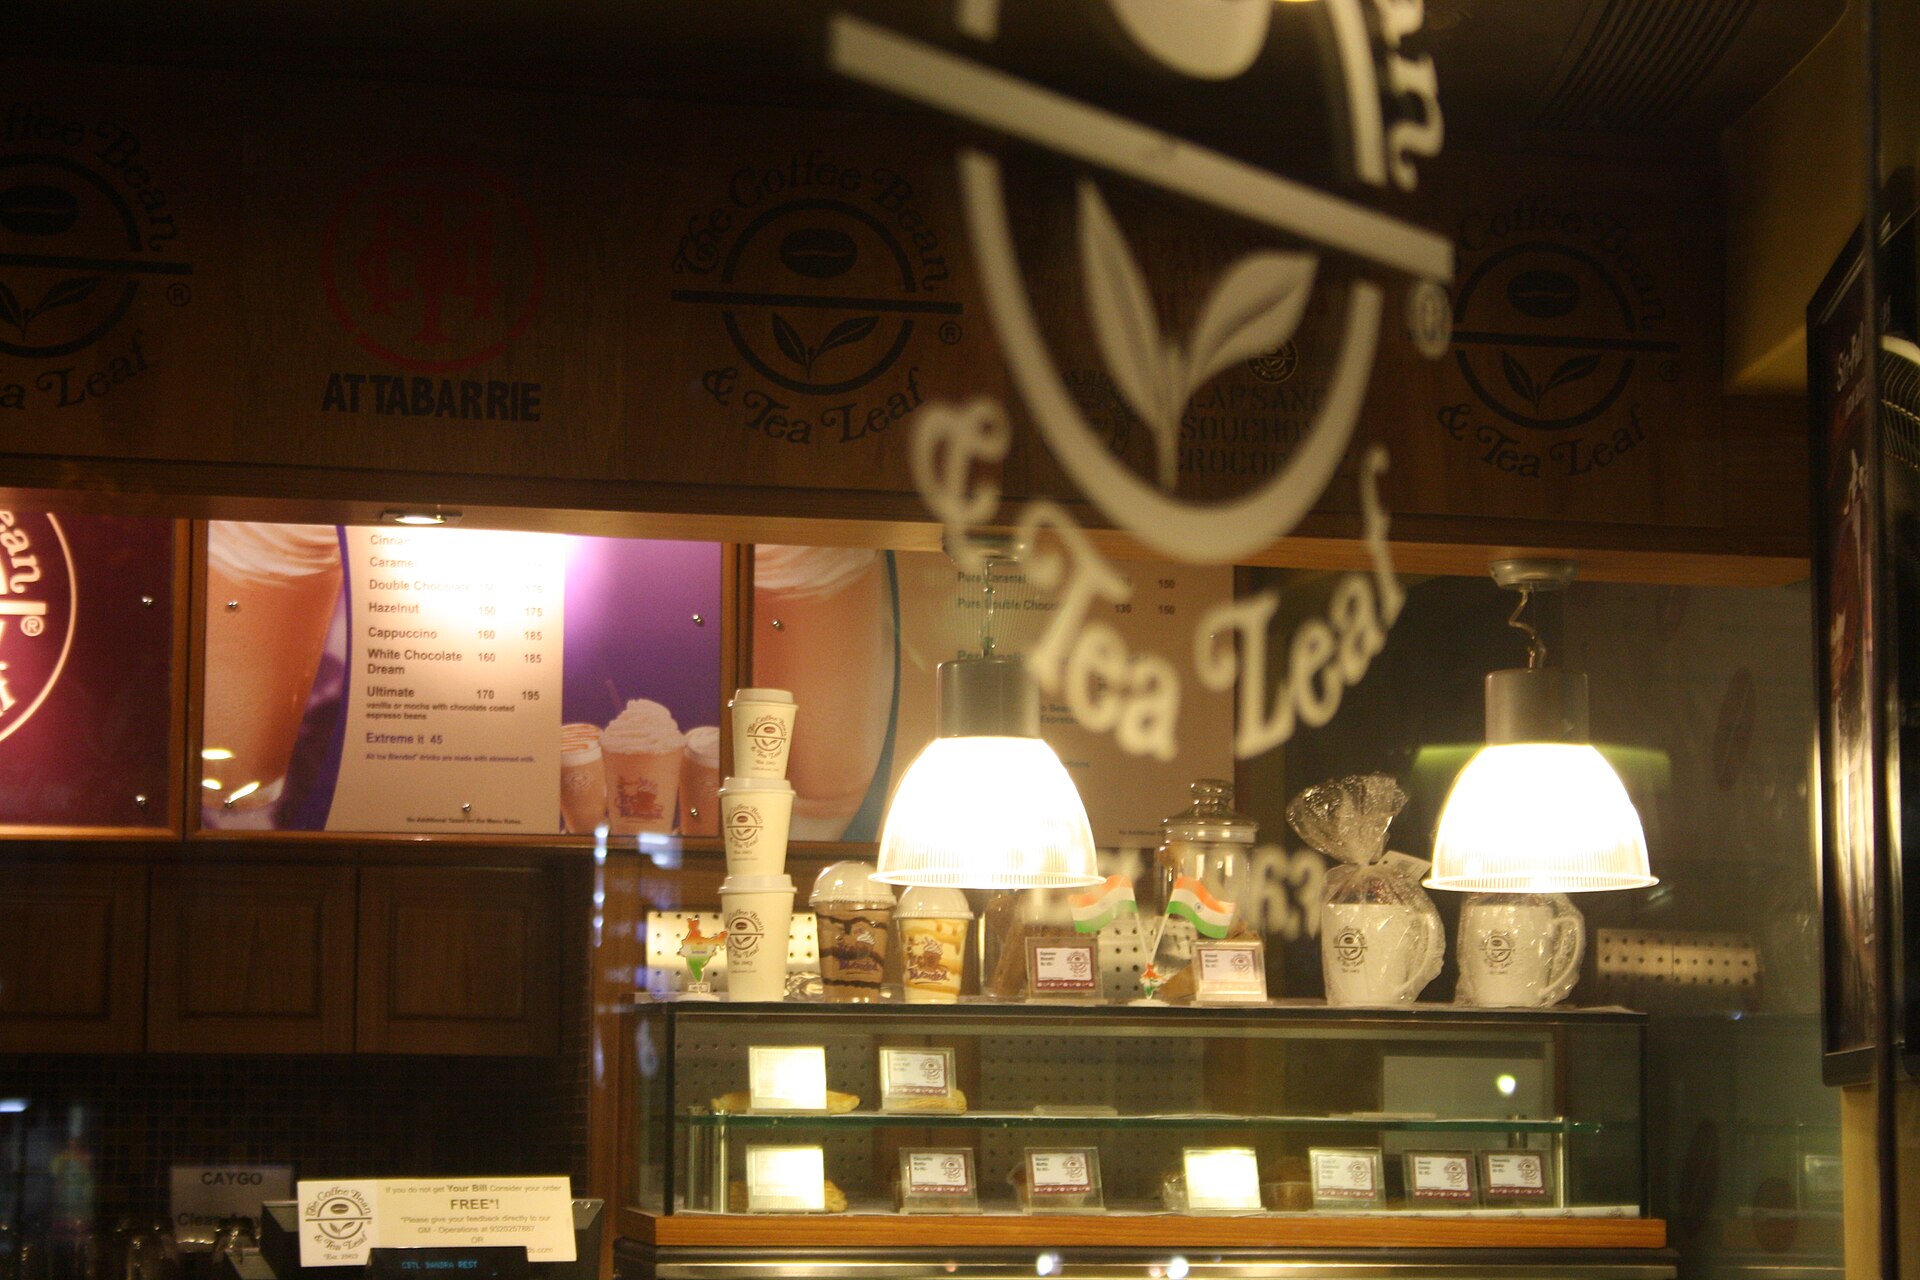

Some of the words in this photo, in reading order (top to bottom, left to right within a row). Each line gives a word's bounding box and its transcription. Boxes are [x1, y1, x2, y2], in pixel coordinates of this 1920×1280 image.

[33, 327, 149, 409] Leaf
[742, 389, 812, 444] Tea
[820, 365, 924, 444] Leaf
[1476, 424, 1541, 479] Tea
[1551, 402, 1646, 477] Leaf
[369, 579, 410, 591] Double
[368, 602, 420, 614] Hazelnut
[524, 607, 543, 617] 175
[1193, 445, 1406, 761] Leaf
[368, 626, 438, 641] Cappuccino
[477, 630, 496, 640] 160
[524, 631, 543, 641] 185
[367, 648, 400, 660] White
[404, 650, 463, 662] Chocolate
[477, 652, 496, 662] 160
[523, 654, 542, 664] 185
[367, 663, 405, 675] Dream
[366, 686, 415, 698] Ultimate
[476, 689, 495, 700] 170
[521, 690, 540, 701] 195
[431, 703, 448, 711] with
[366, 732, 414, 744] Extreme
[430, 734, 443, 744] 45
[201, 1172, 263, 1186] CAYGO
[392, 1187, 406, 1195] you
[408, 1185, 417, 1193] do
[446, 1184, 469, 1193] Your
[472, 1184, 488, 1192] Bill
[489, 1184, 522, 1193] Consider
[524, 1186, 541, 1194] your
